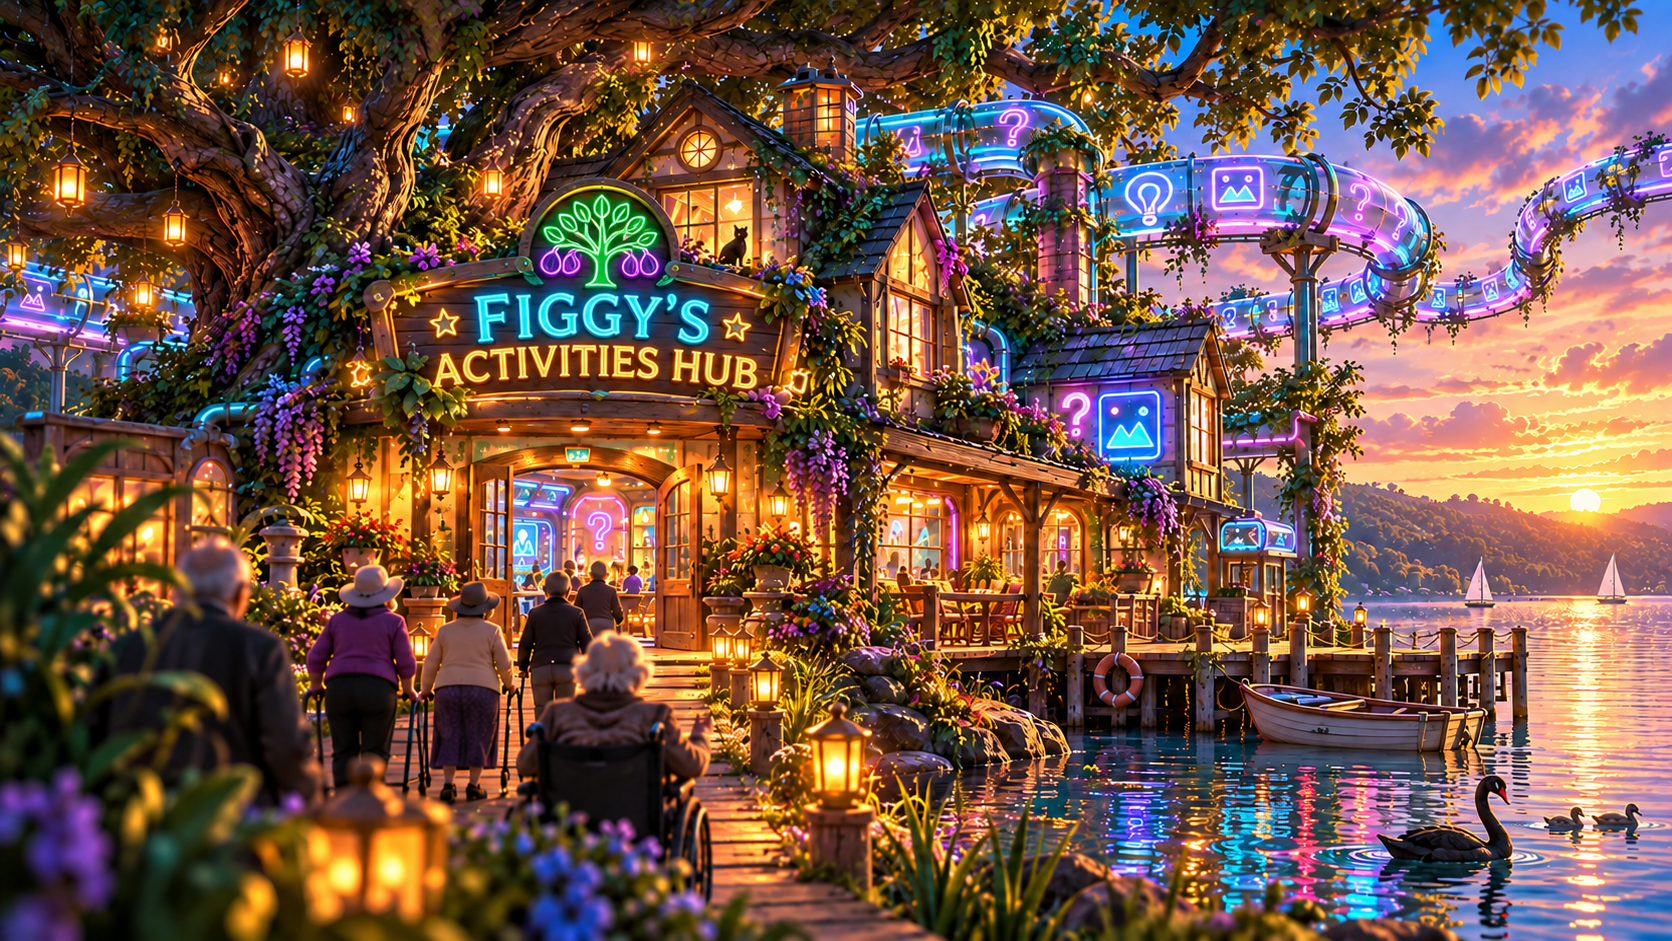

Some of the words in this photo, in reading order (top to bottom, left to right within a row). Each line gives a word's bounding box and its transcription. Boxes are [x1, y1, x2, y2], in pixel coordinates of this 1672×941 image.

[474, 292, 710, 344] FIGGY'S
[433, 344, 659, 387] ACTIVITIES
[672, 348, 759, 390] HUB
